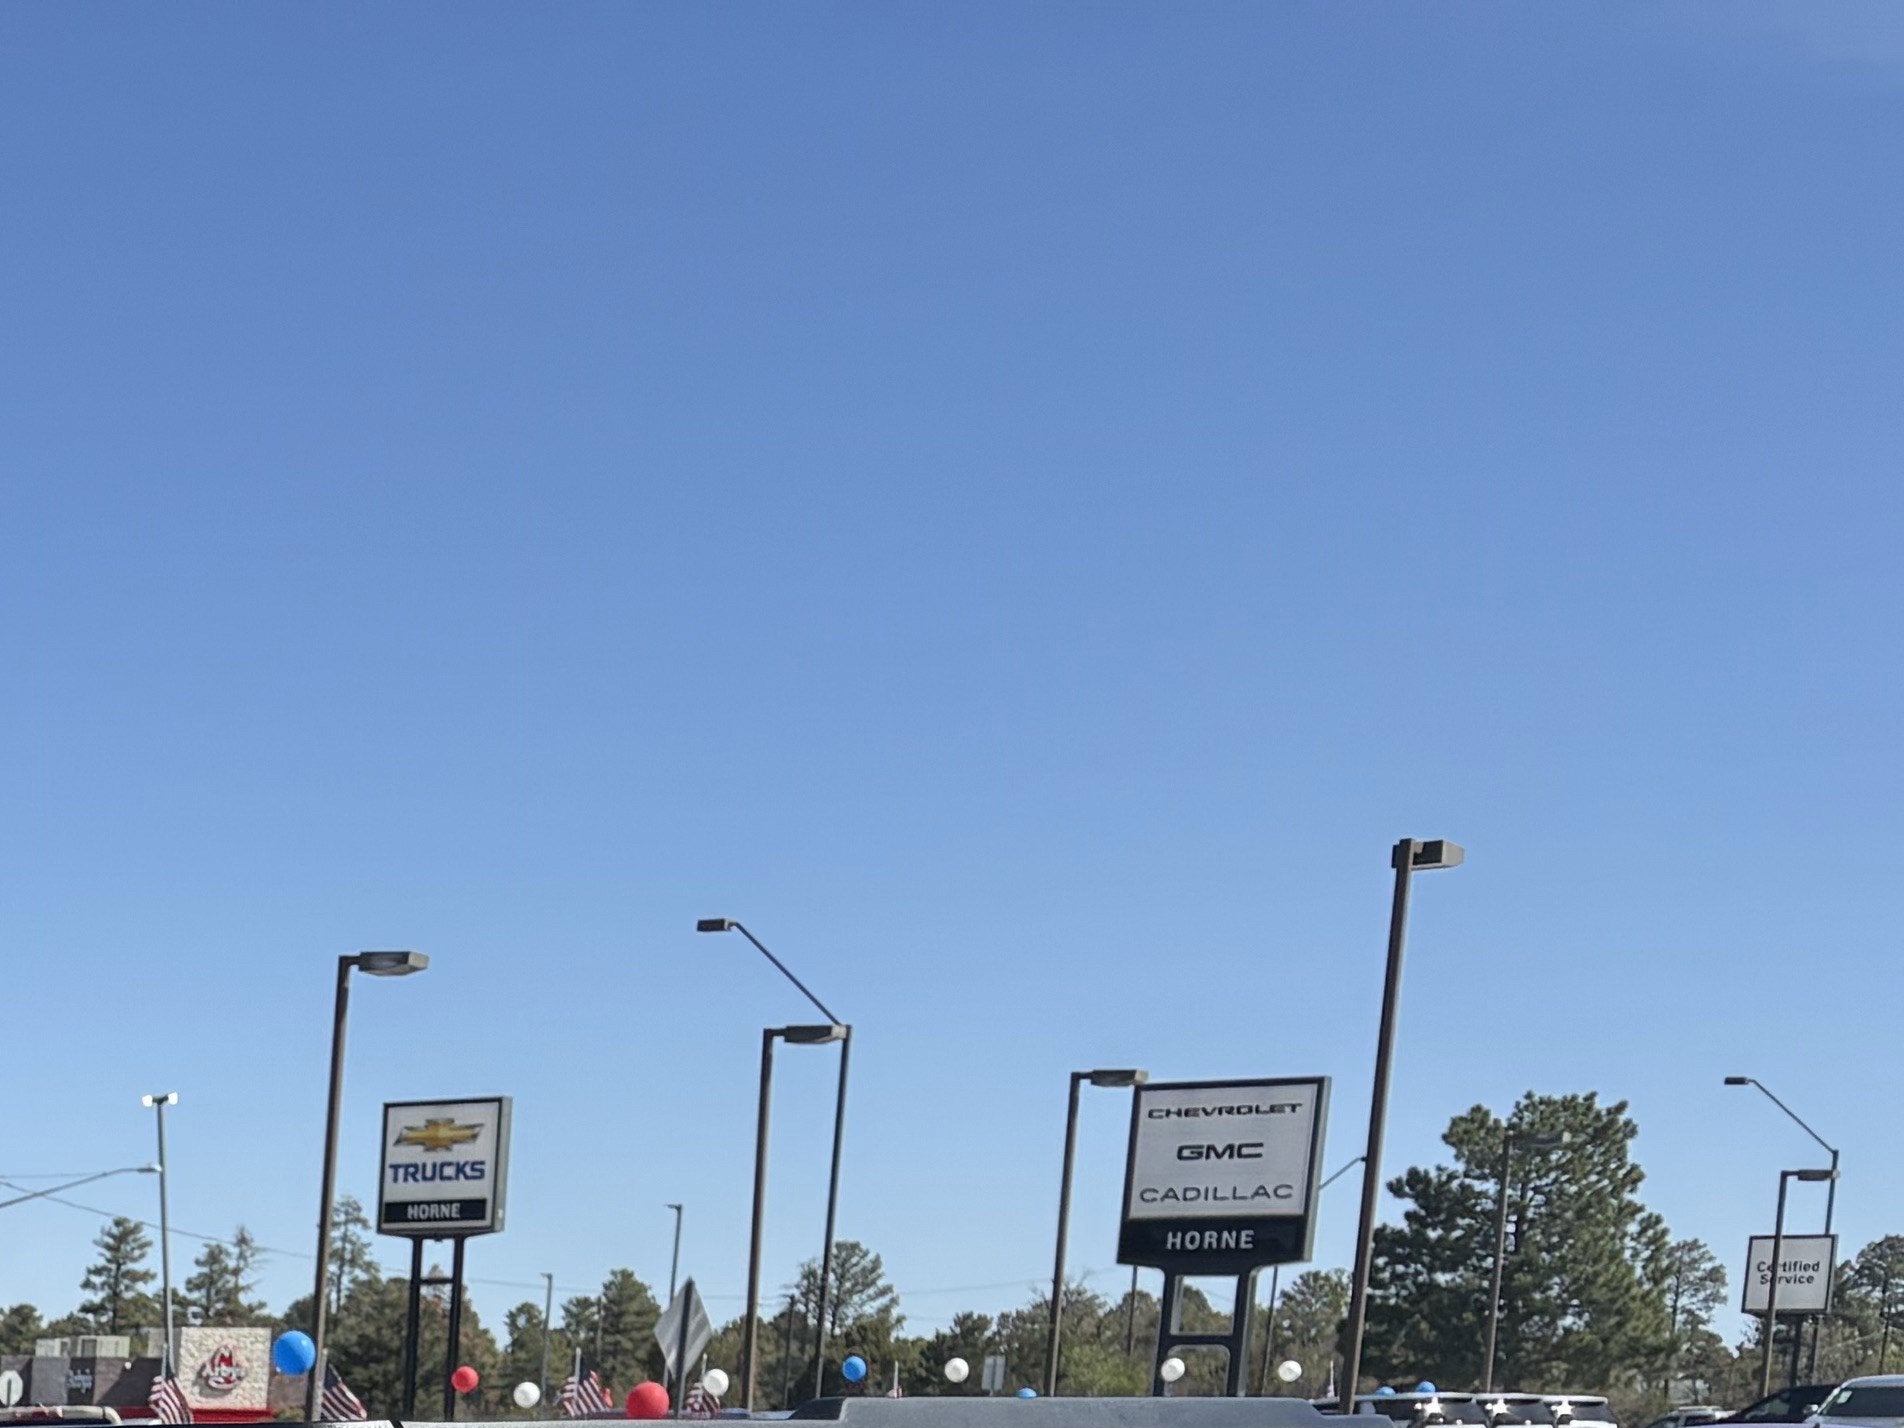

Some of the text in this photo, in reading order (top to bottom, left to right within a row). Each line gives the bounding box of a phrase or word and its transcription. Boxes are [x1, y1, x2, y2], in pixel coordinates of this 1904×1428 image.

[1148, 1103, 1303, 1119] CHEVROLET
[1177, 1142, 1264, 1161] GMC
[389, 1160, 486, 1183] TRUCKS
[1139, 1184, 1294, 1203] CADILLAC
[406, 1203, 460, 1220] HORNE
[1166, 1229, 1255, 1250] HORNE
[1757, 1261, 1820, 1273] Cetified
[1760, 1274, 1815, 1285] Srvice
